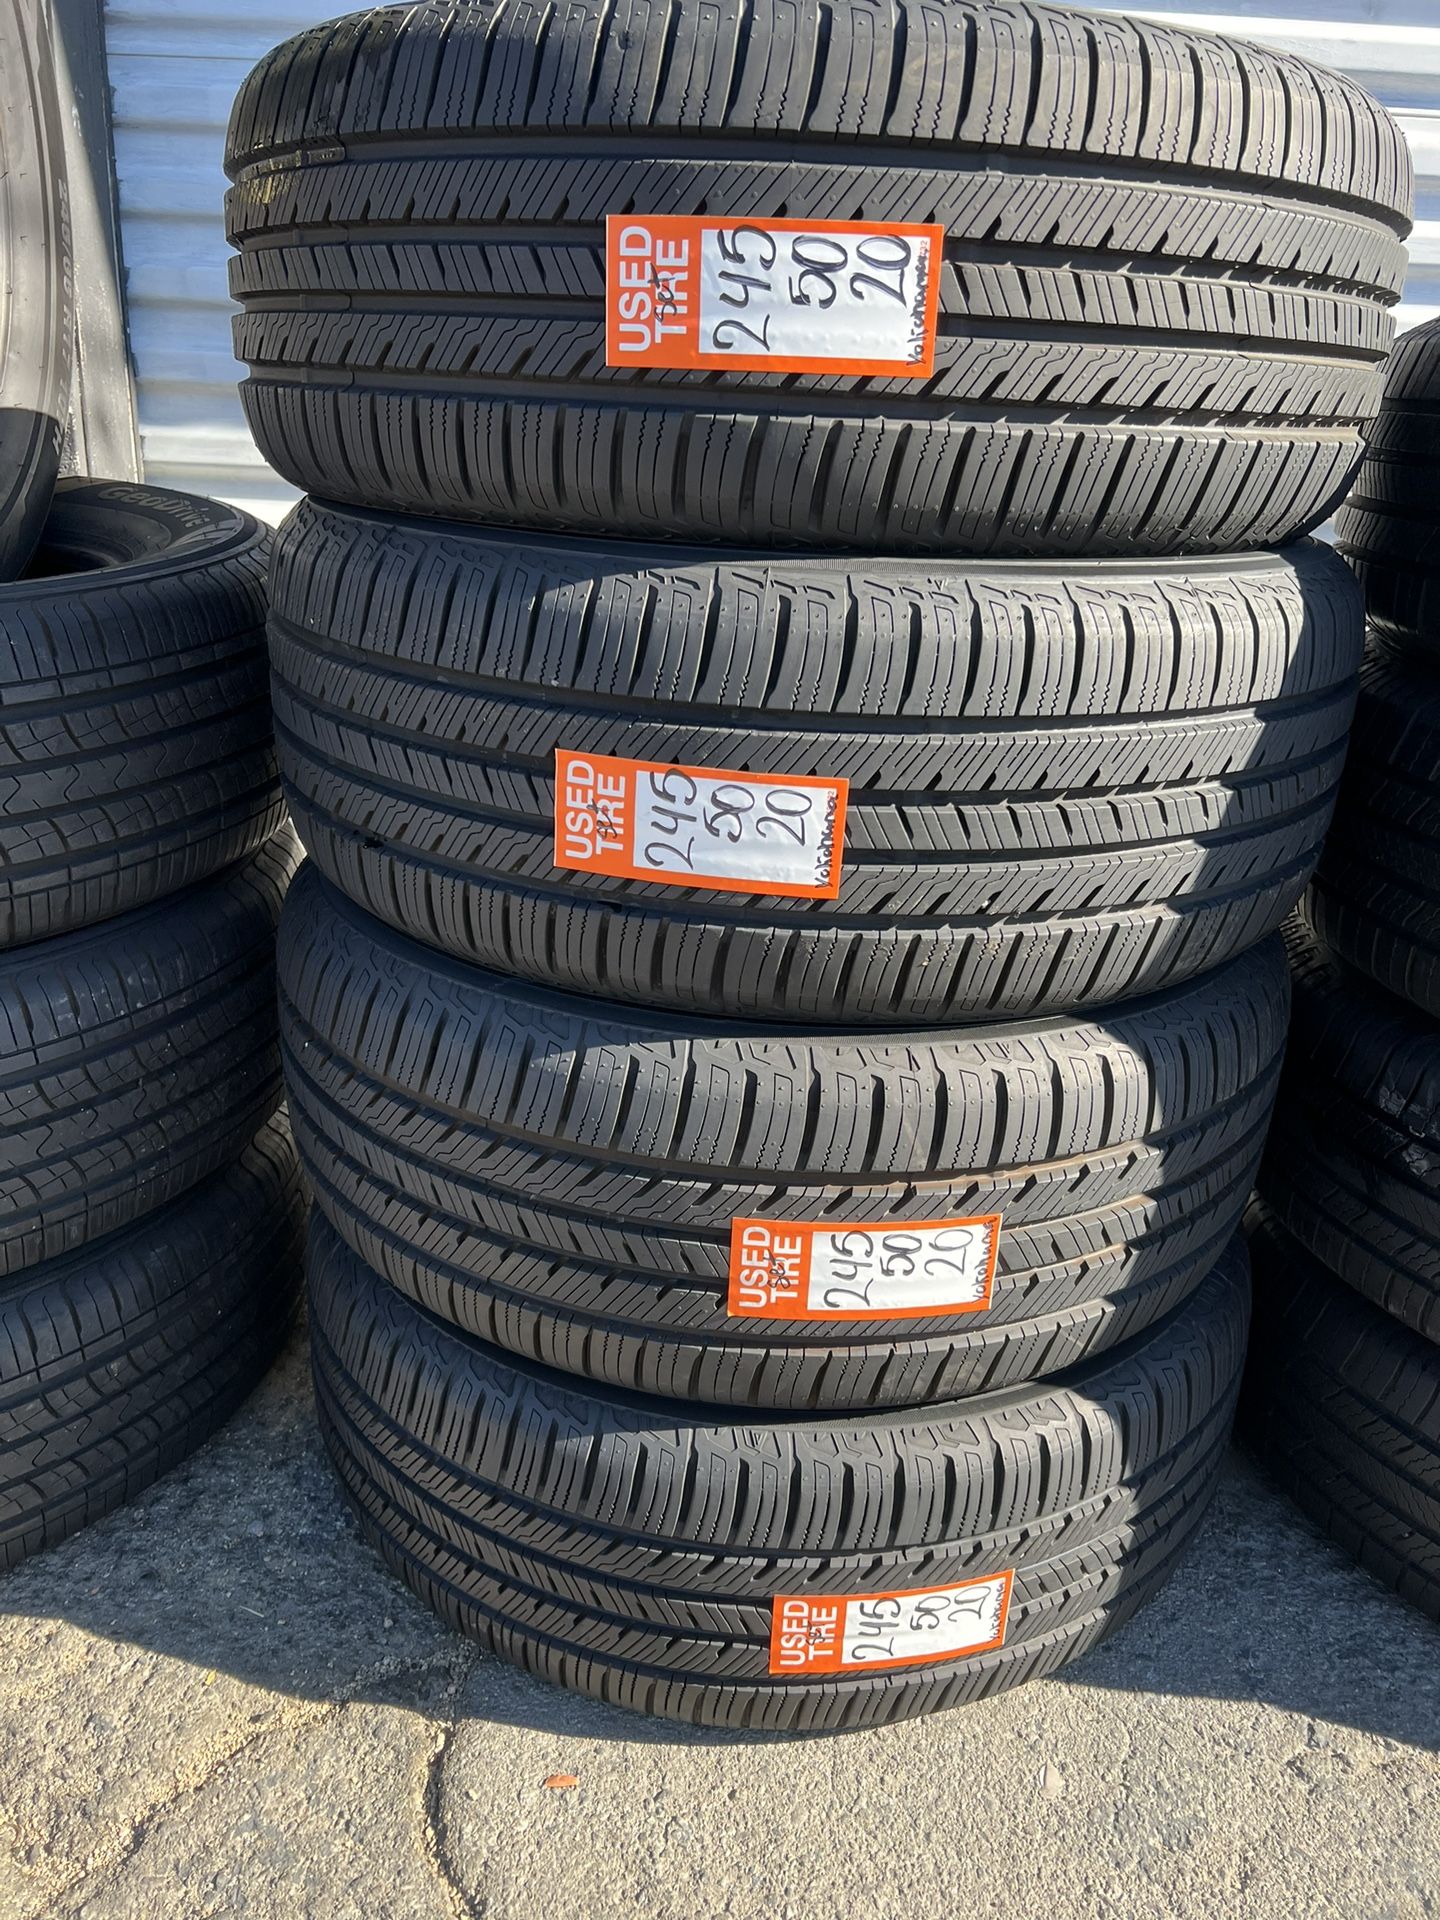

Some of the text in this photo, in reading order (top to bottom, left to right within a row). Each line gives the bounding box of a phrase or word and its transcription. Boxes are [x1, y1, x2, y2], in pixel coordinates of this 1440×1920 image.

[619, 226, 653, 352] USED
[655, 239, 689, 343] TIRE
[713, 224, 776, 351] 245
[789, 234, 848, 309] 50
[850, 234, 911, 306] 20
[565, 760, 595, 859] USED
[596, 774, 625, 855] TIRE
[645, 768, 697, 870] 245
[703, 784, 755, 843] 50
[756, 789, 812, 846] 20
[739, 1226, 771, 1308] USED
[770, 1236, 802, 1303] TIRE
[824, 1230, 874, 1308] 245
[880, 1234, 922, 1277] 50
[924, 1229, 973, 1275] 20
[780, 1601, 809, 1665] USED
[808, 1606, 837, 1660] TIRE
[852, 1597, 901, 1660] 245
[910, 1595, 950, 1631] 50
[948, 1585, 991, 1623] 20
